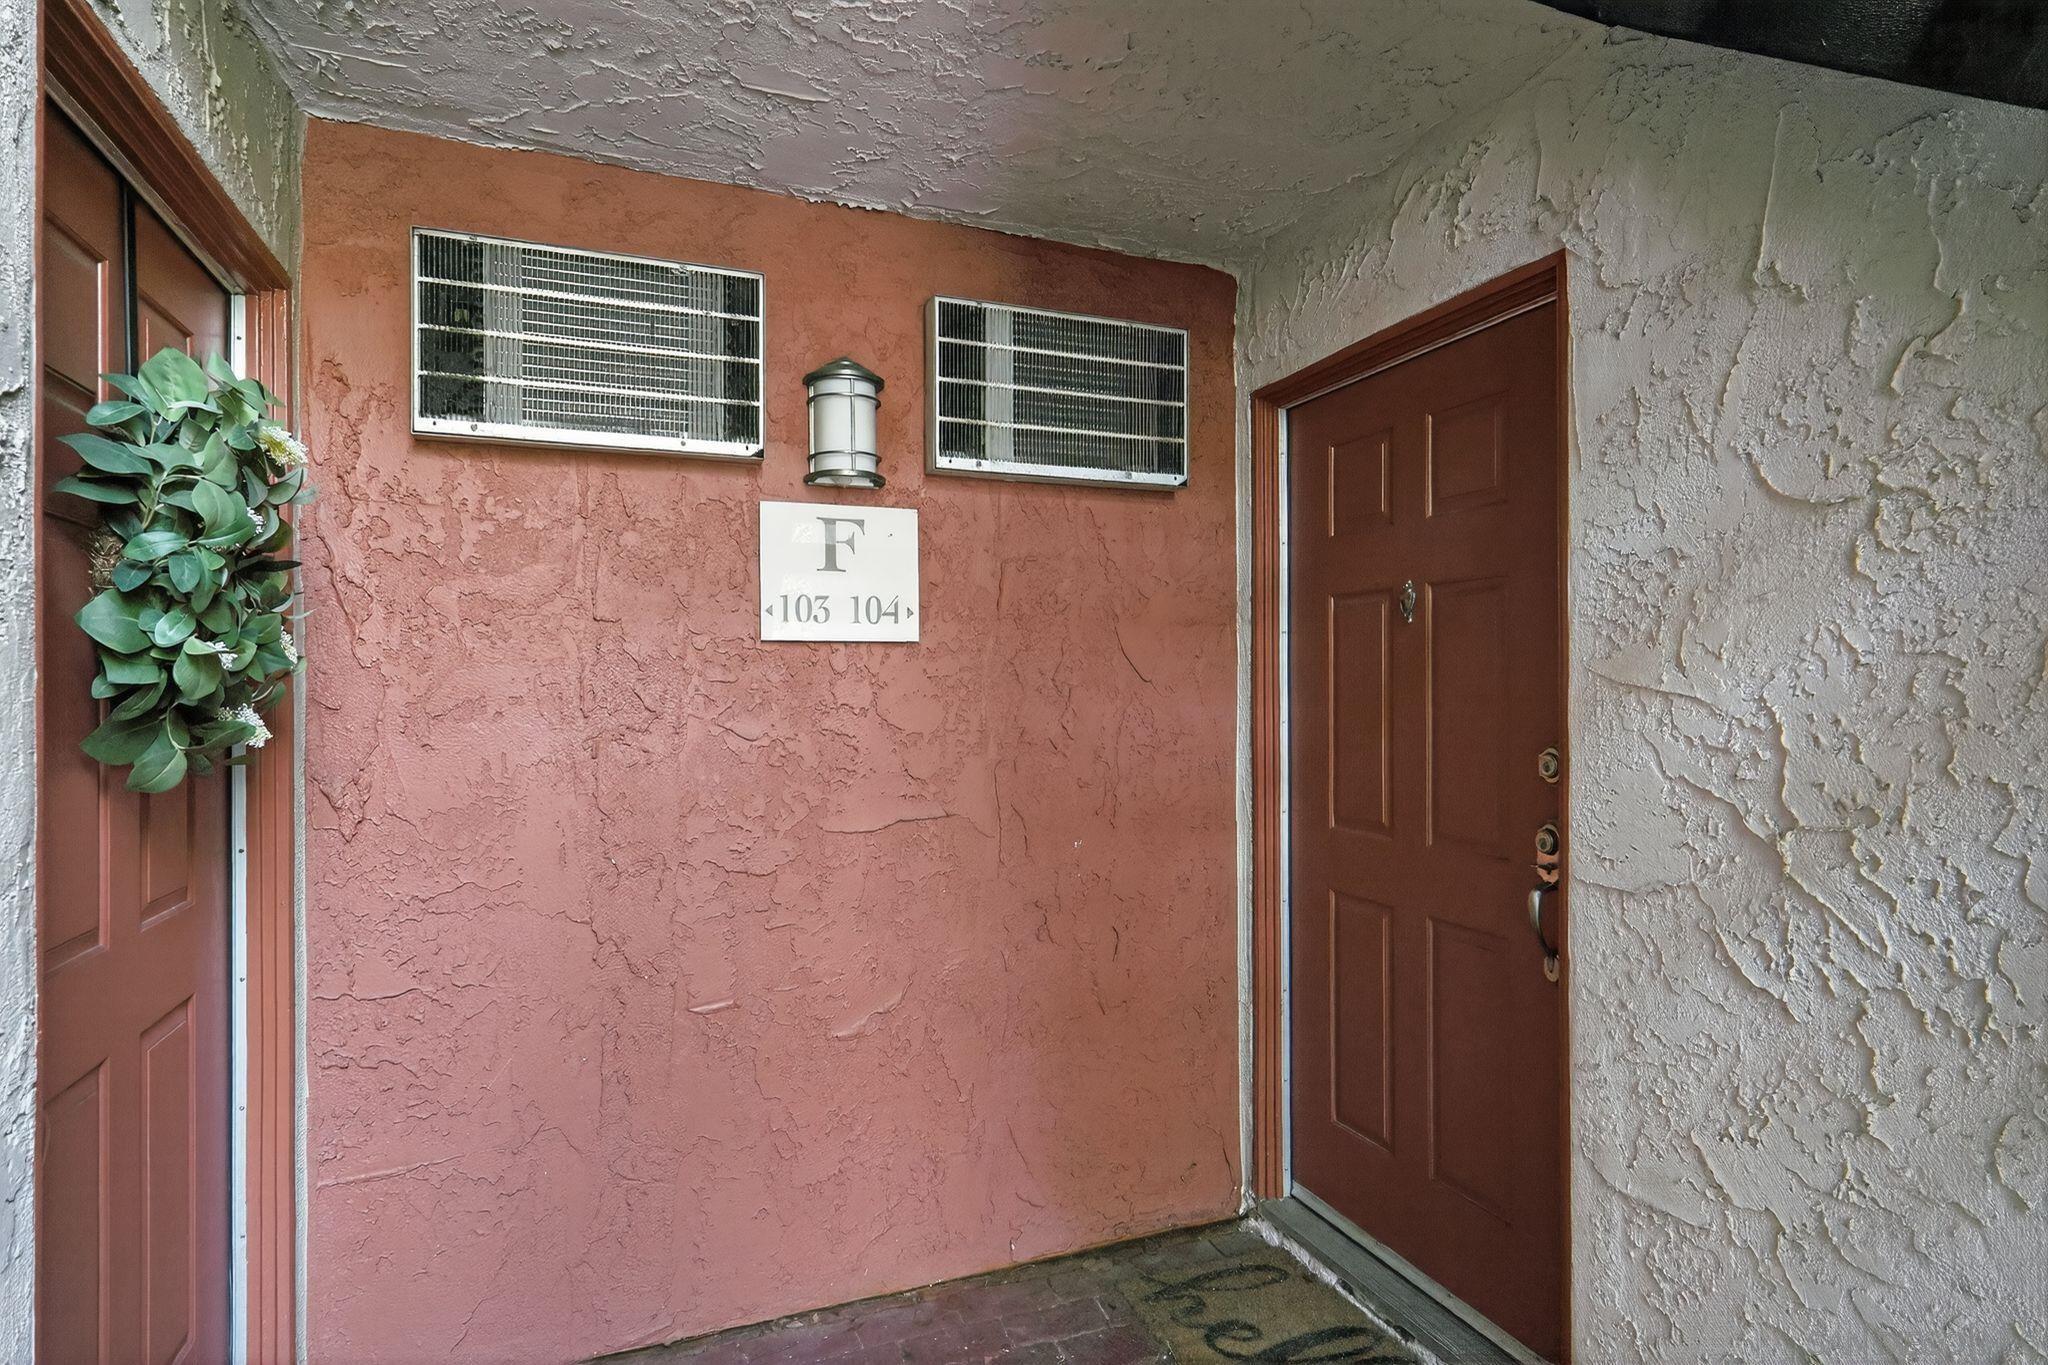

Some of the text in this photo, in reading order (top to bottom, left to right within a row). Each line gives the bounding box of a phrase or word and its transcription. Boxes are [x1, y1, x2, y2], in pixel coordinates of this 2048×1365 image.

[816, 516, 865, 573] F
[779, 594, 899, 625] 103 104
